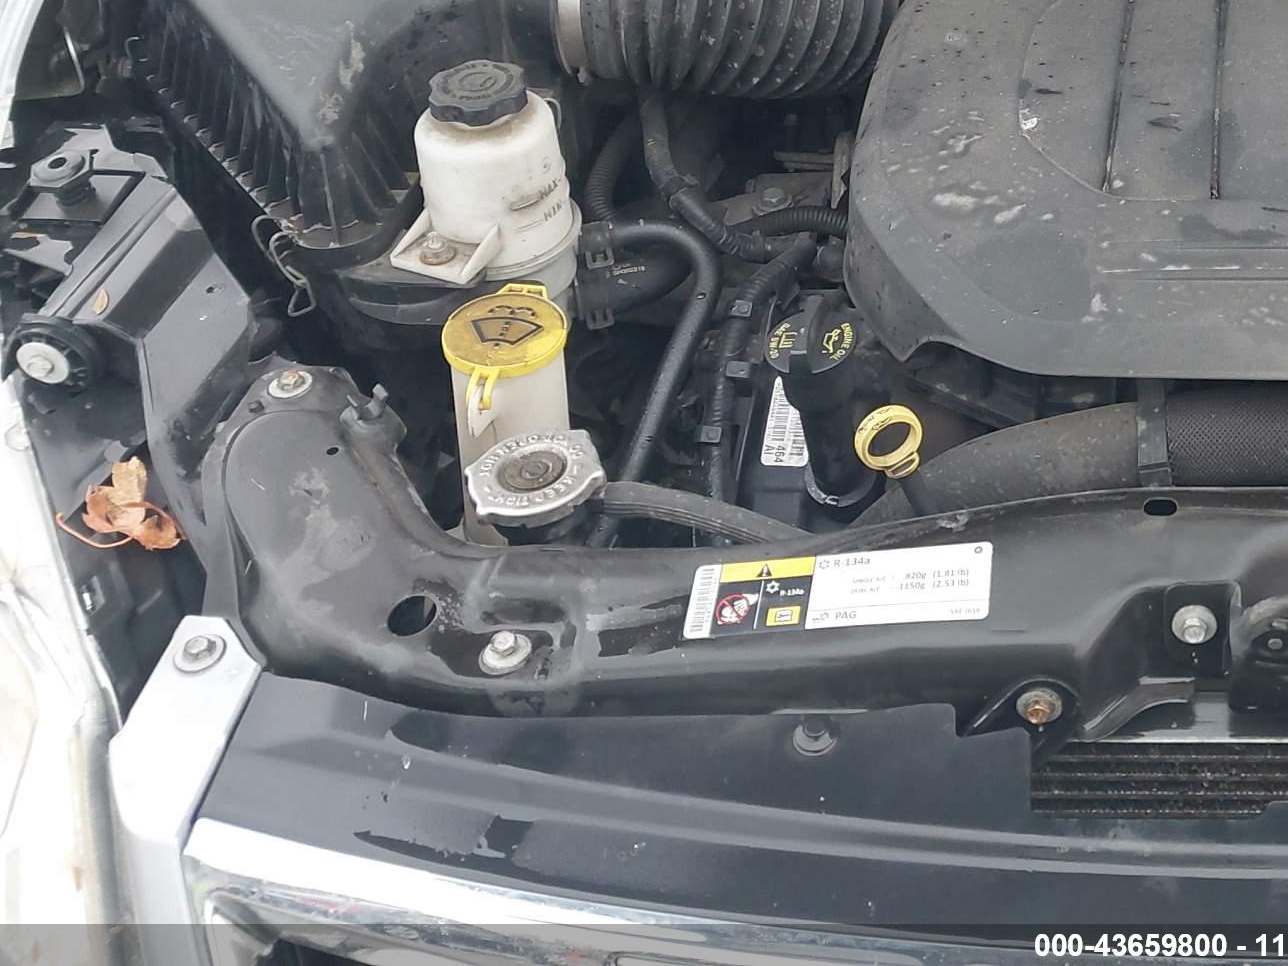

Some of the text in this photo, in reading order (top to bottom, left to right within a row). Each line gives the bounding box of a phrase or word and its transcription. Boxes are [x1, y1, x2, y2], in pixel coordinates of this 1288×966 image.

[829, 322, 853, 360] ENGINE OIL
[774, 445, 786, 462] 464
[834, 557, 870, 567] R-134a
[905, 571, 926, 580] 820g
[932, 569, 954, 578] (1.81
[958, 568, 970, 576] lb)
[900, 581, 926, 590] 1150g
[932, 580, 954, 588] (2.53
[958, 578, 970, 587] lb)
[835, 611, 857, 620] PAG
